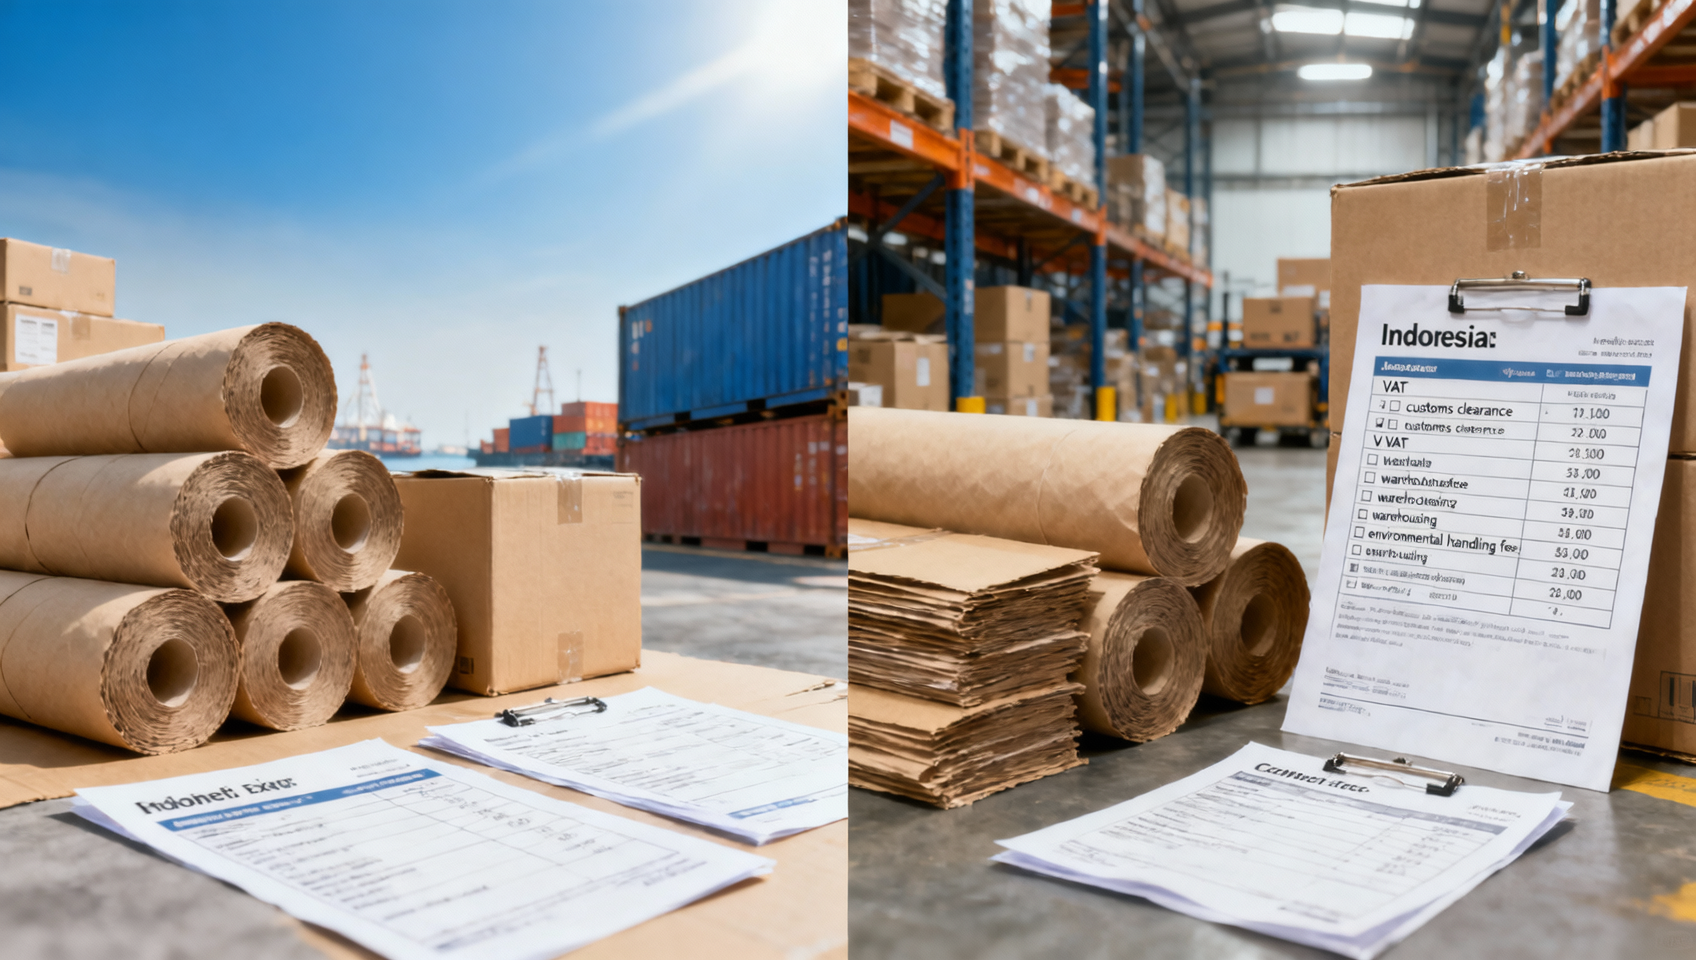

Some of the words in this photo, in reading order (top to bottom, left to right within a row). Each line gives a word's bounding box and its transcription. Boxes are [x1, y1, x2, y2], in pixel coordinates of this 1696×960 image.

[1383, 380, 1409, 393] VAT
[1406, 402, 1453, 415] customs
[1457, 402, 1514, 417] clearance
[1386, 436, 1409, 449] VAT
[1368, 527, 1443, 546] environmental
[1446, 533, 1497, 556] handling
